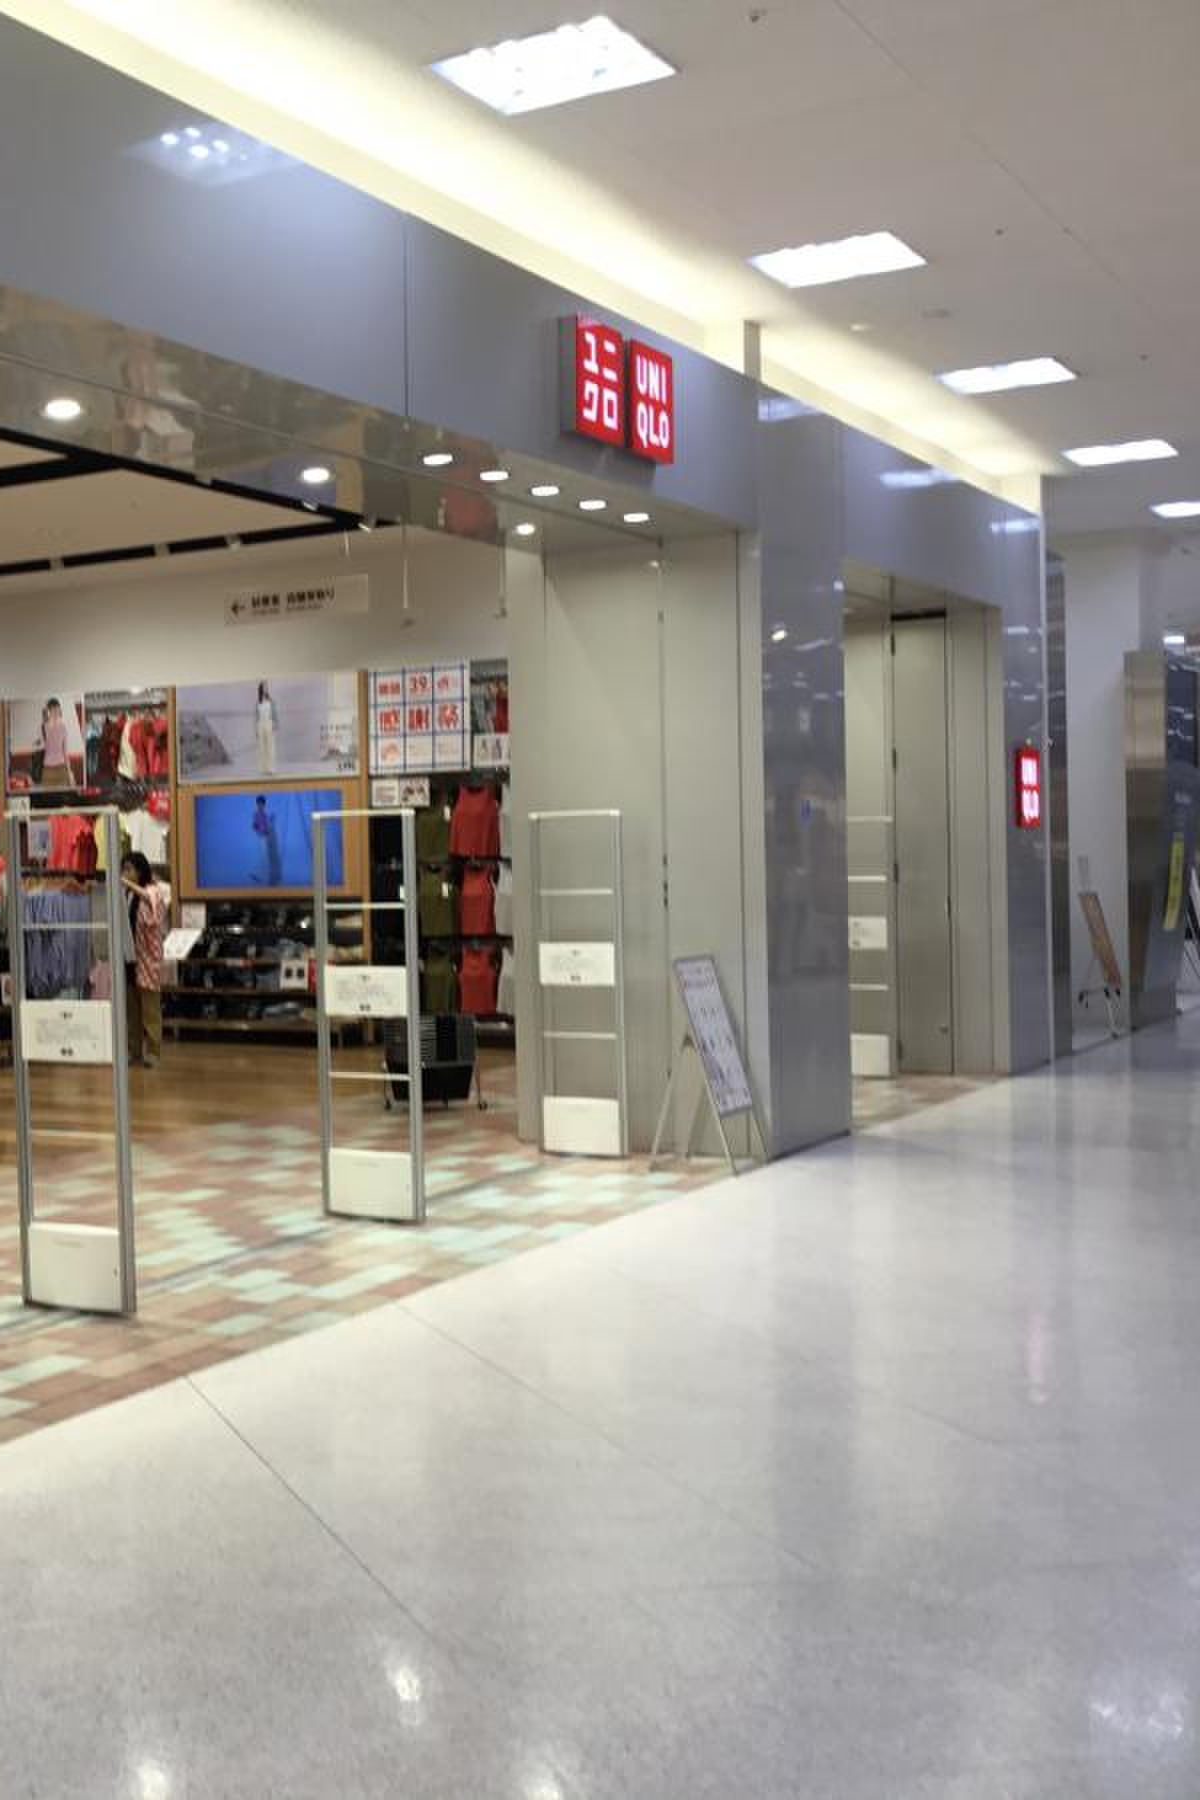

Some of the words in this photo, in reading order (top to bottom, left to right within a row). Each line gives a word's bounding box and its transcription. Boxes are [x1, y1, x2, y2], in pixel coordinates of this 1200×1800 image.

[582, 331, 618, 382] ユニ
[636, 354, 667, 405] UNI
[582, 379, 618, 431] クロ
[636, 401, 670, 449] QLO
